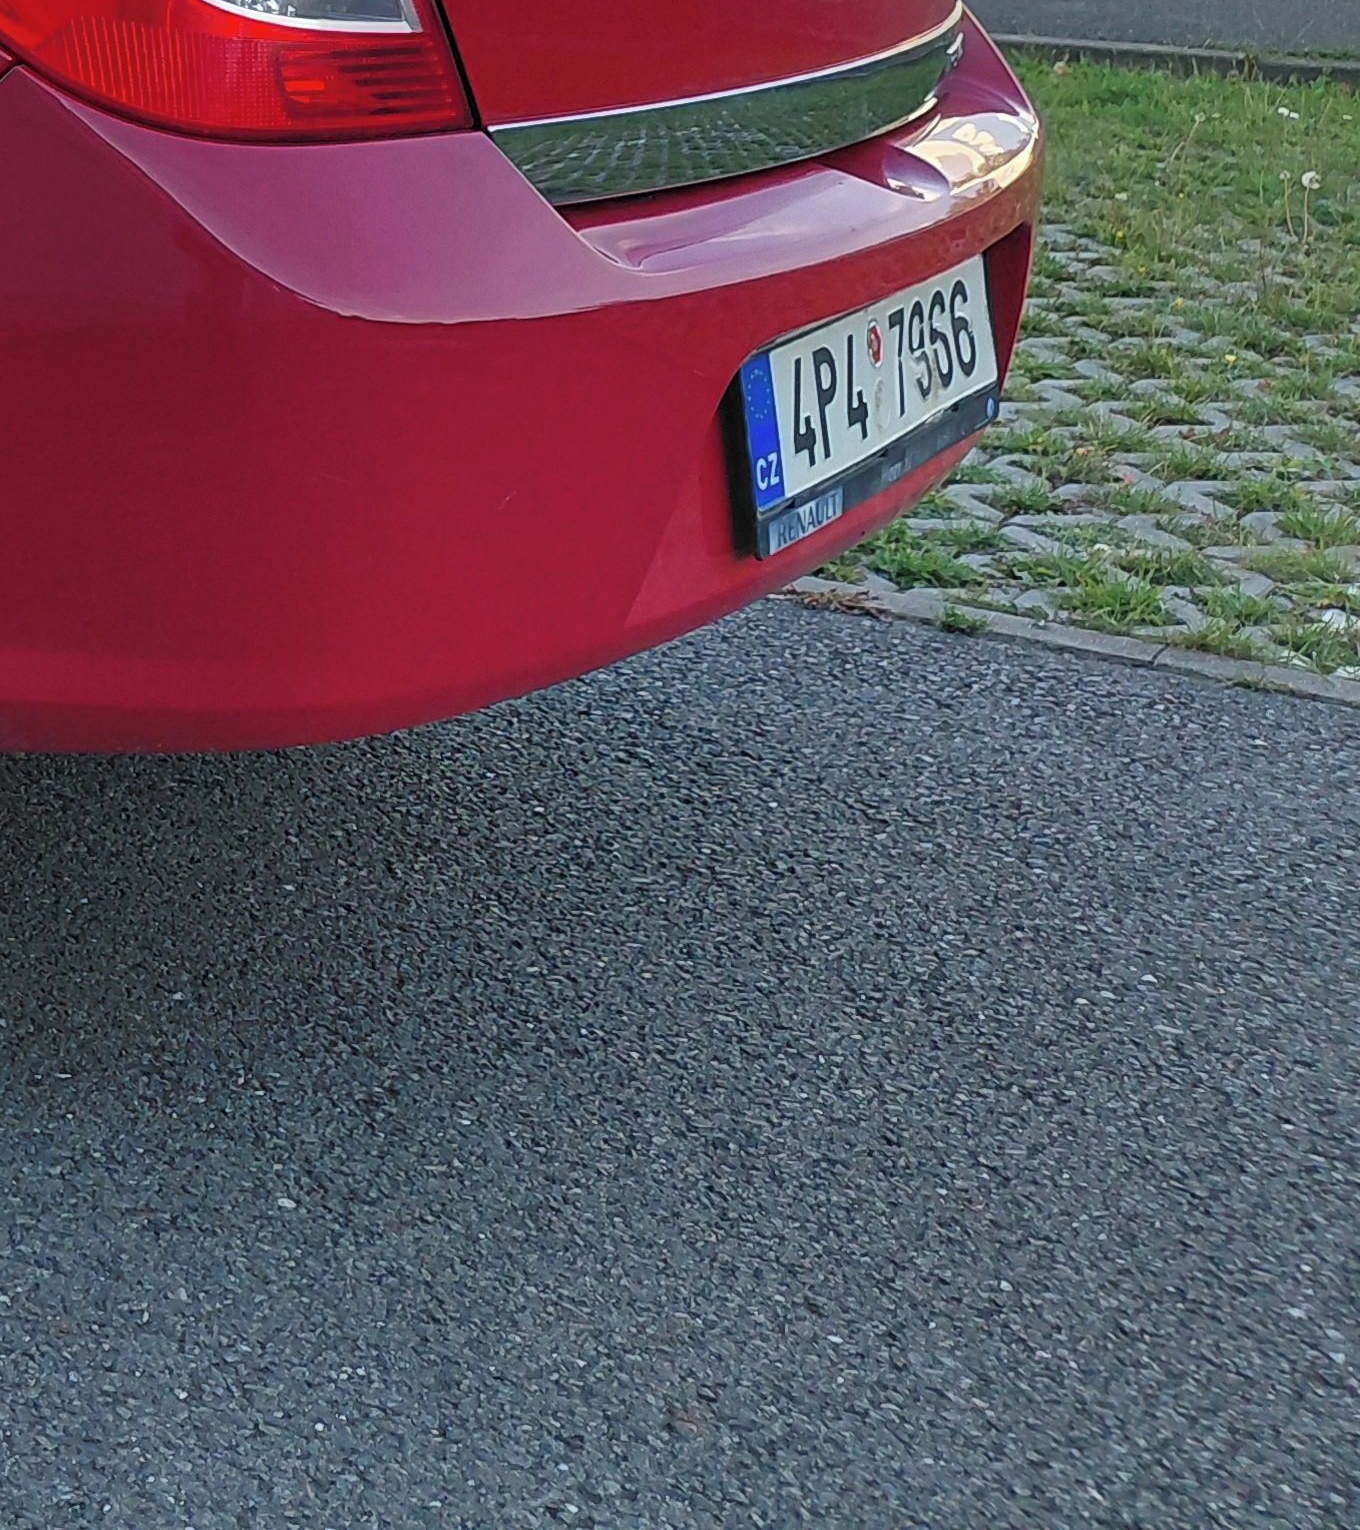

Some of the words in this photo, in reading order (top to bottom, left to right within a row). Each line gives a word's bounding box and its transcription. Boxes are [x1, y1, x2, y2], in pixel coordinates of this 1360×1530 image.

[793, 334, 869, 468] 4P4
[888, 279, 977, 418] 7966
[756, 451, 781, 492] CZ
